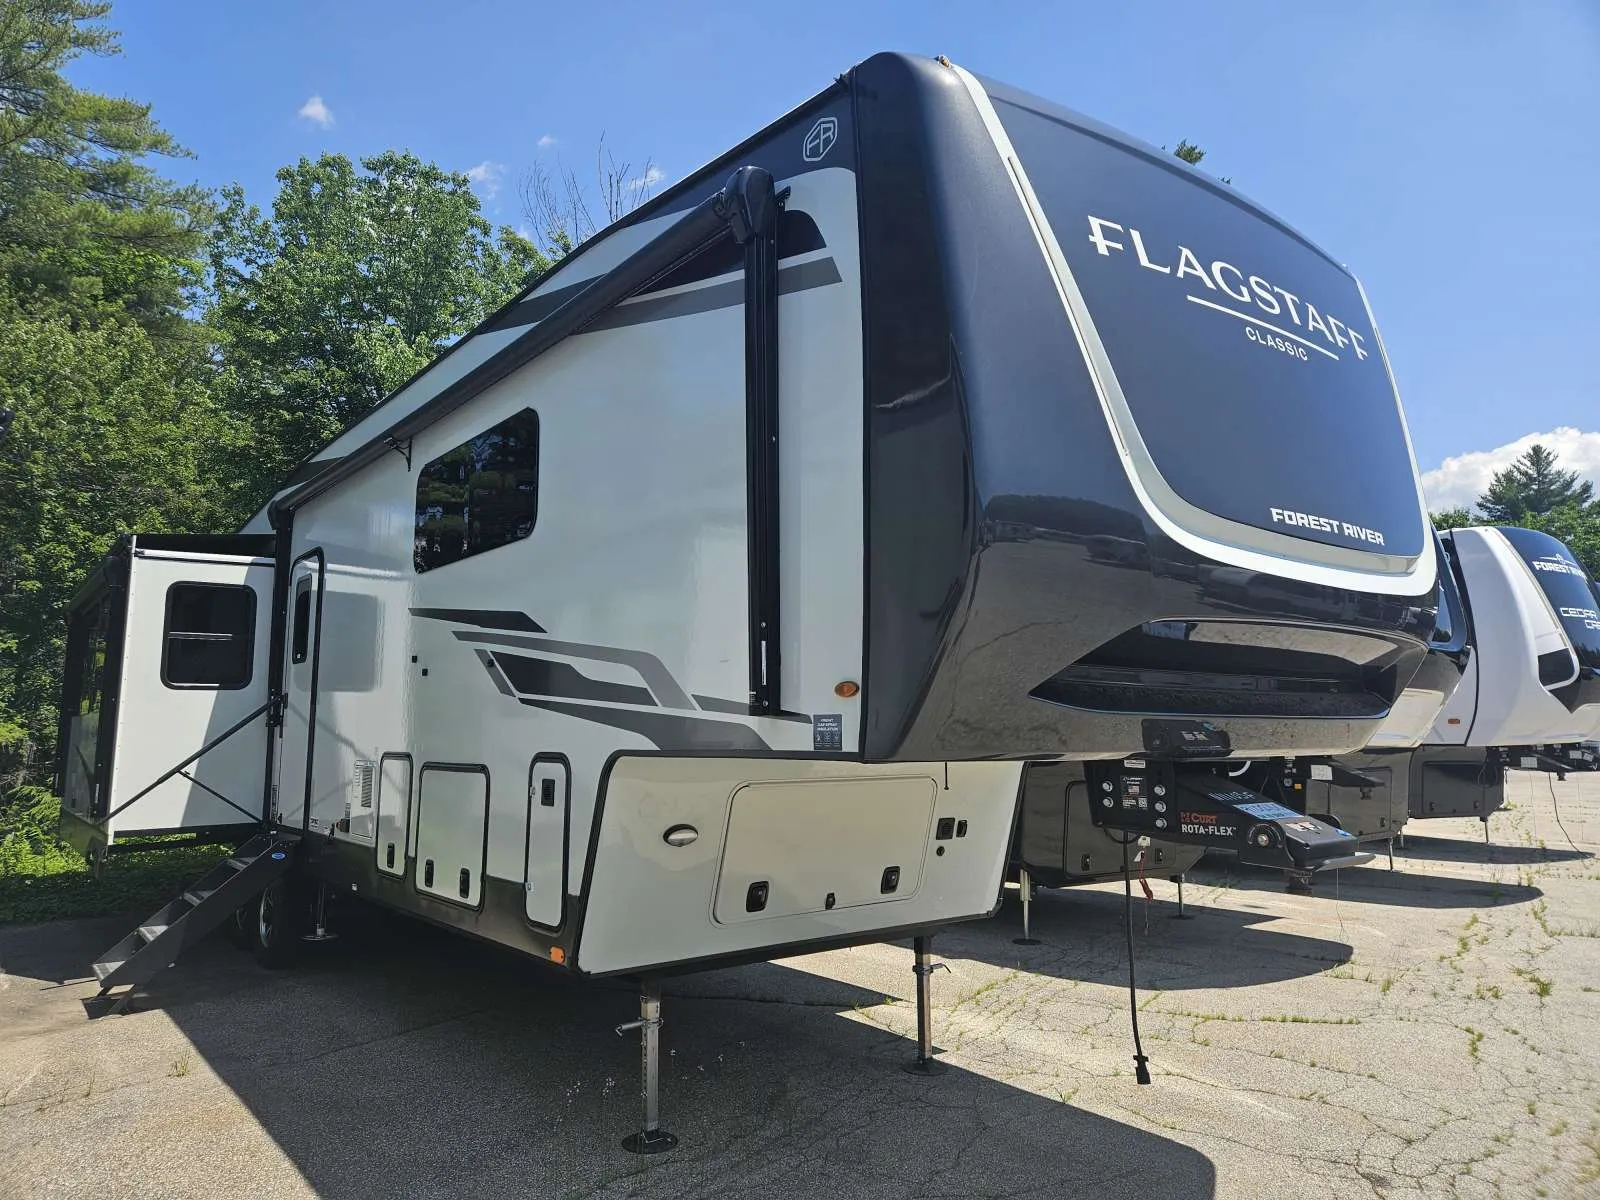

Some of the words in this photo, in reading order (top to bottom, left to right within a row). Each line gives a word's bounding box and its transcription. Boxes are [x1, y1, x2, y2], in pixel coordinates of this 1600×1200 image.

[1088, 215, 1368, 360] FLAGSTAFF
[1245, 326, 1308, 361] CLASSIC
[1270, 507, 1340, 534] FOREST
[1341, 522, 1385, 546] RIVER
[1532, 560, 1570, 574] FOREST
[1560, 607, 1597, 619] CEDAR
[1191, 812, 1217, 824] CURT
